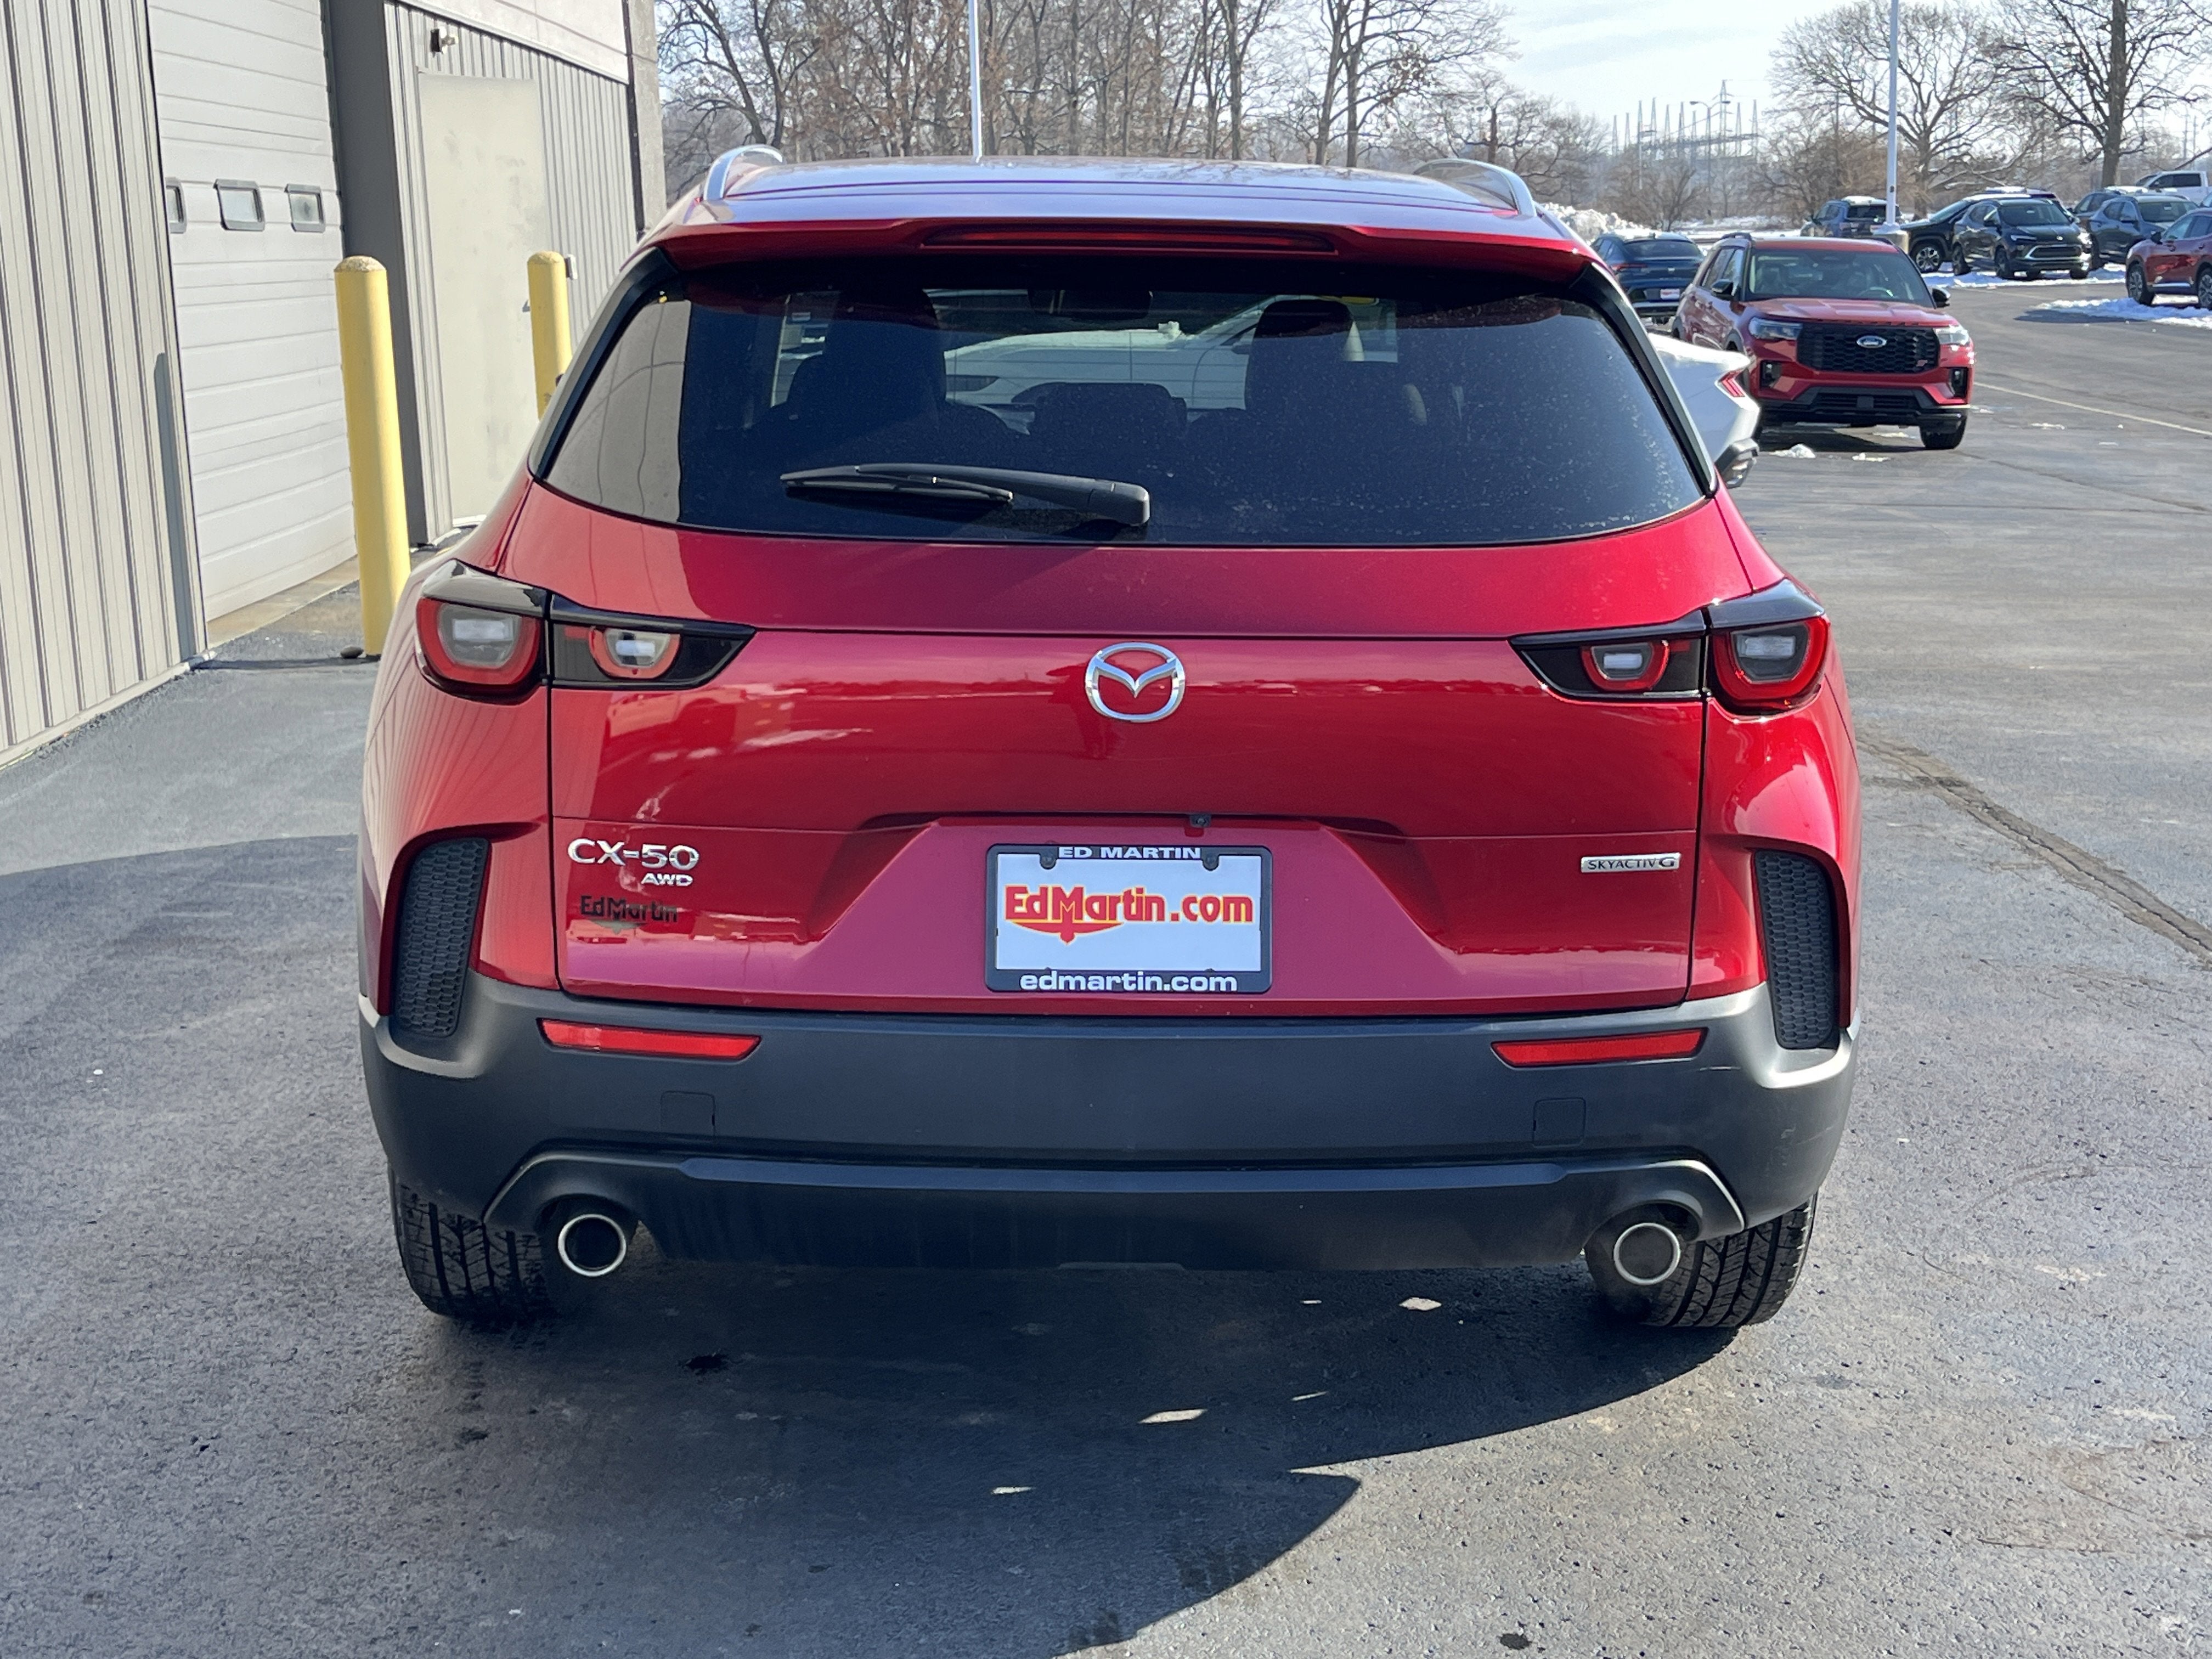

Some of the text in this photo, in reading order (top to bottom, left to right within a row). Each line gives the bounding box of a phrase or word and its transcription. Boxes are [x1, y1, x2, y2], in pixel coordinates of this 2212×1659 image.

[567, 838, 700, 871] CX-50
[1058, 846, 1201, 859] ED MARTIN
[640, 873, 693, 887] AWD
[1019, 970, 1238, 992] edmartin.com
